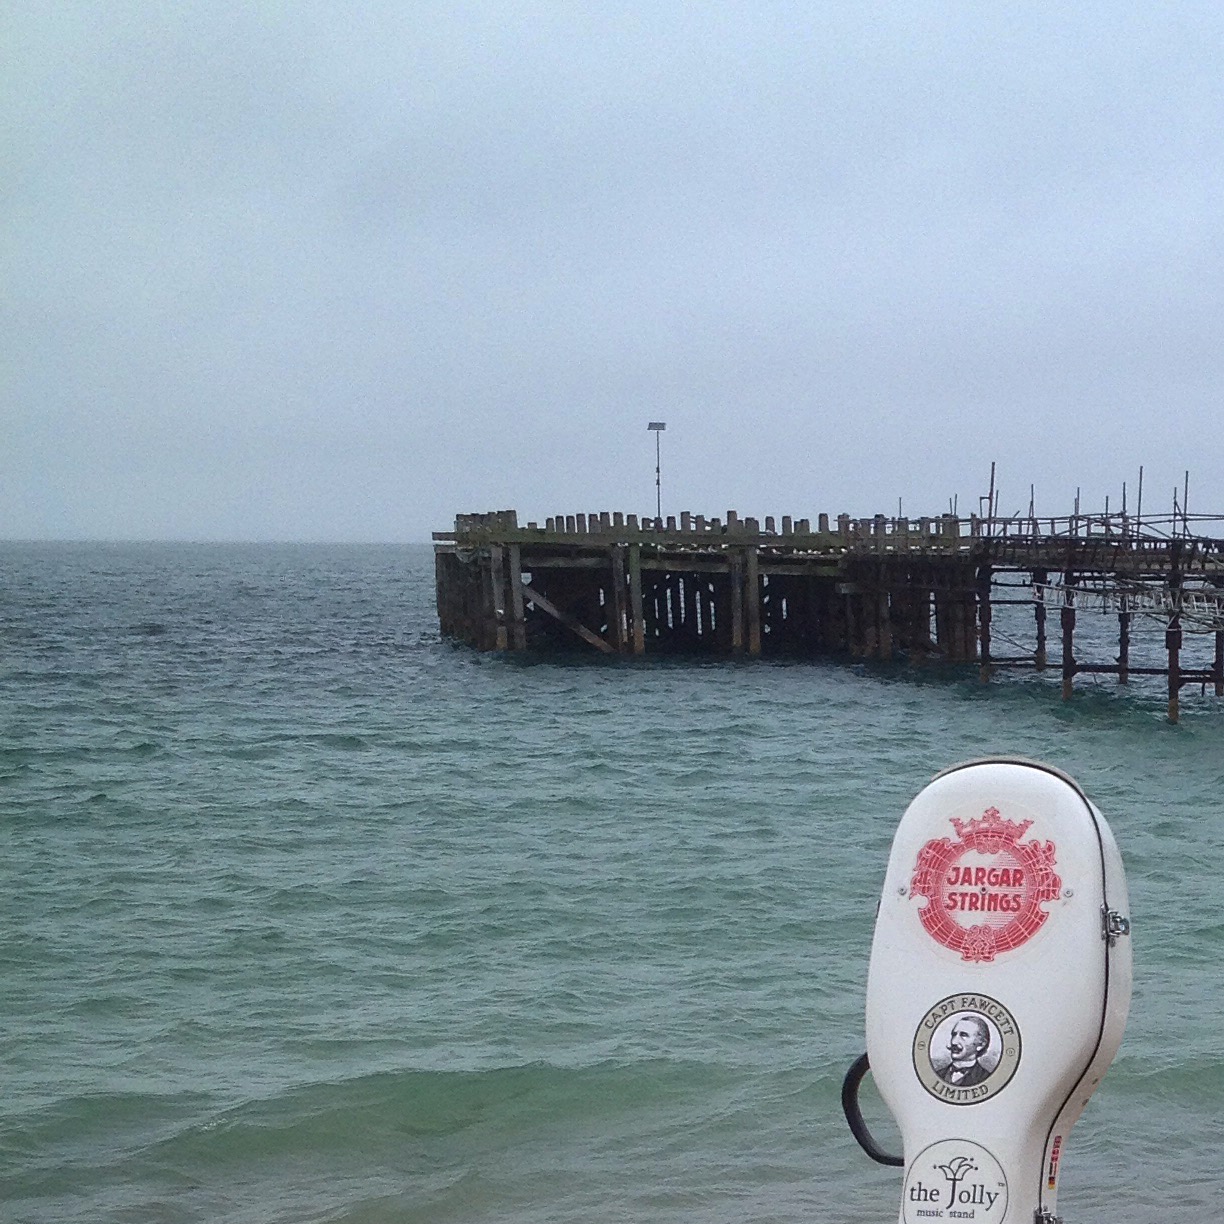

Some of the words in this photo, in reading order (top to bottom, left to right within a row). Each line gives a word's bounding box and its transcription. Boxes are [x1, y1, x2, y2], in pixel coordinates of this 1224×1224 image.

[946, 866, 1024, 887] JARGAR
[944, 892, 1022, 912] STRINGS
[924, 1000, 956, 1030] CAPT
[961, 997, 1014, 1035] FAWCETT
[932, 1080, 989, 1100] LIMITED
[909, 1182, 940, 1202] the
[945, 1180, 999, 1211] Jolly
[916, 1208, 943, 1218] music
[949, 1209, 975, 1219] stand
